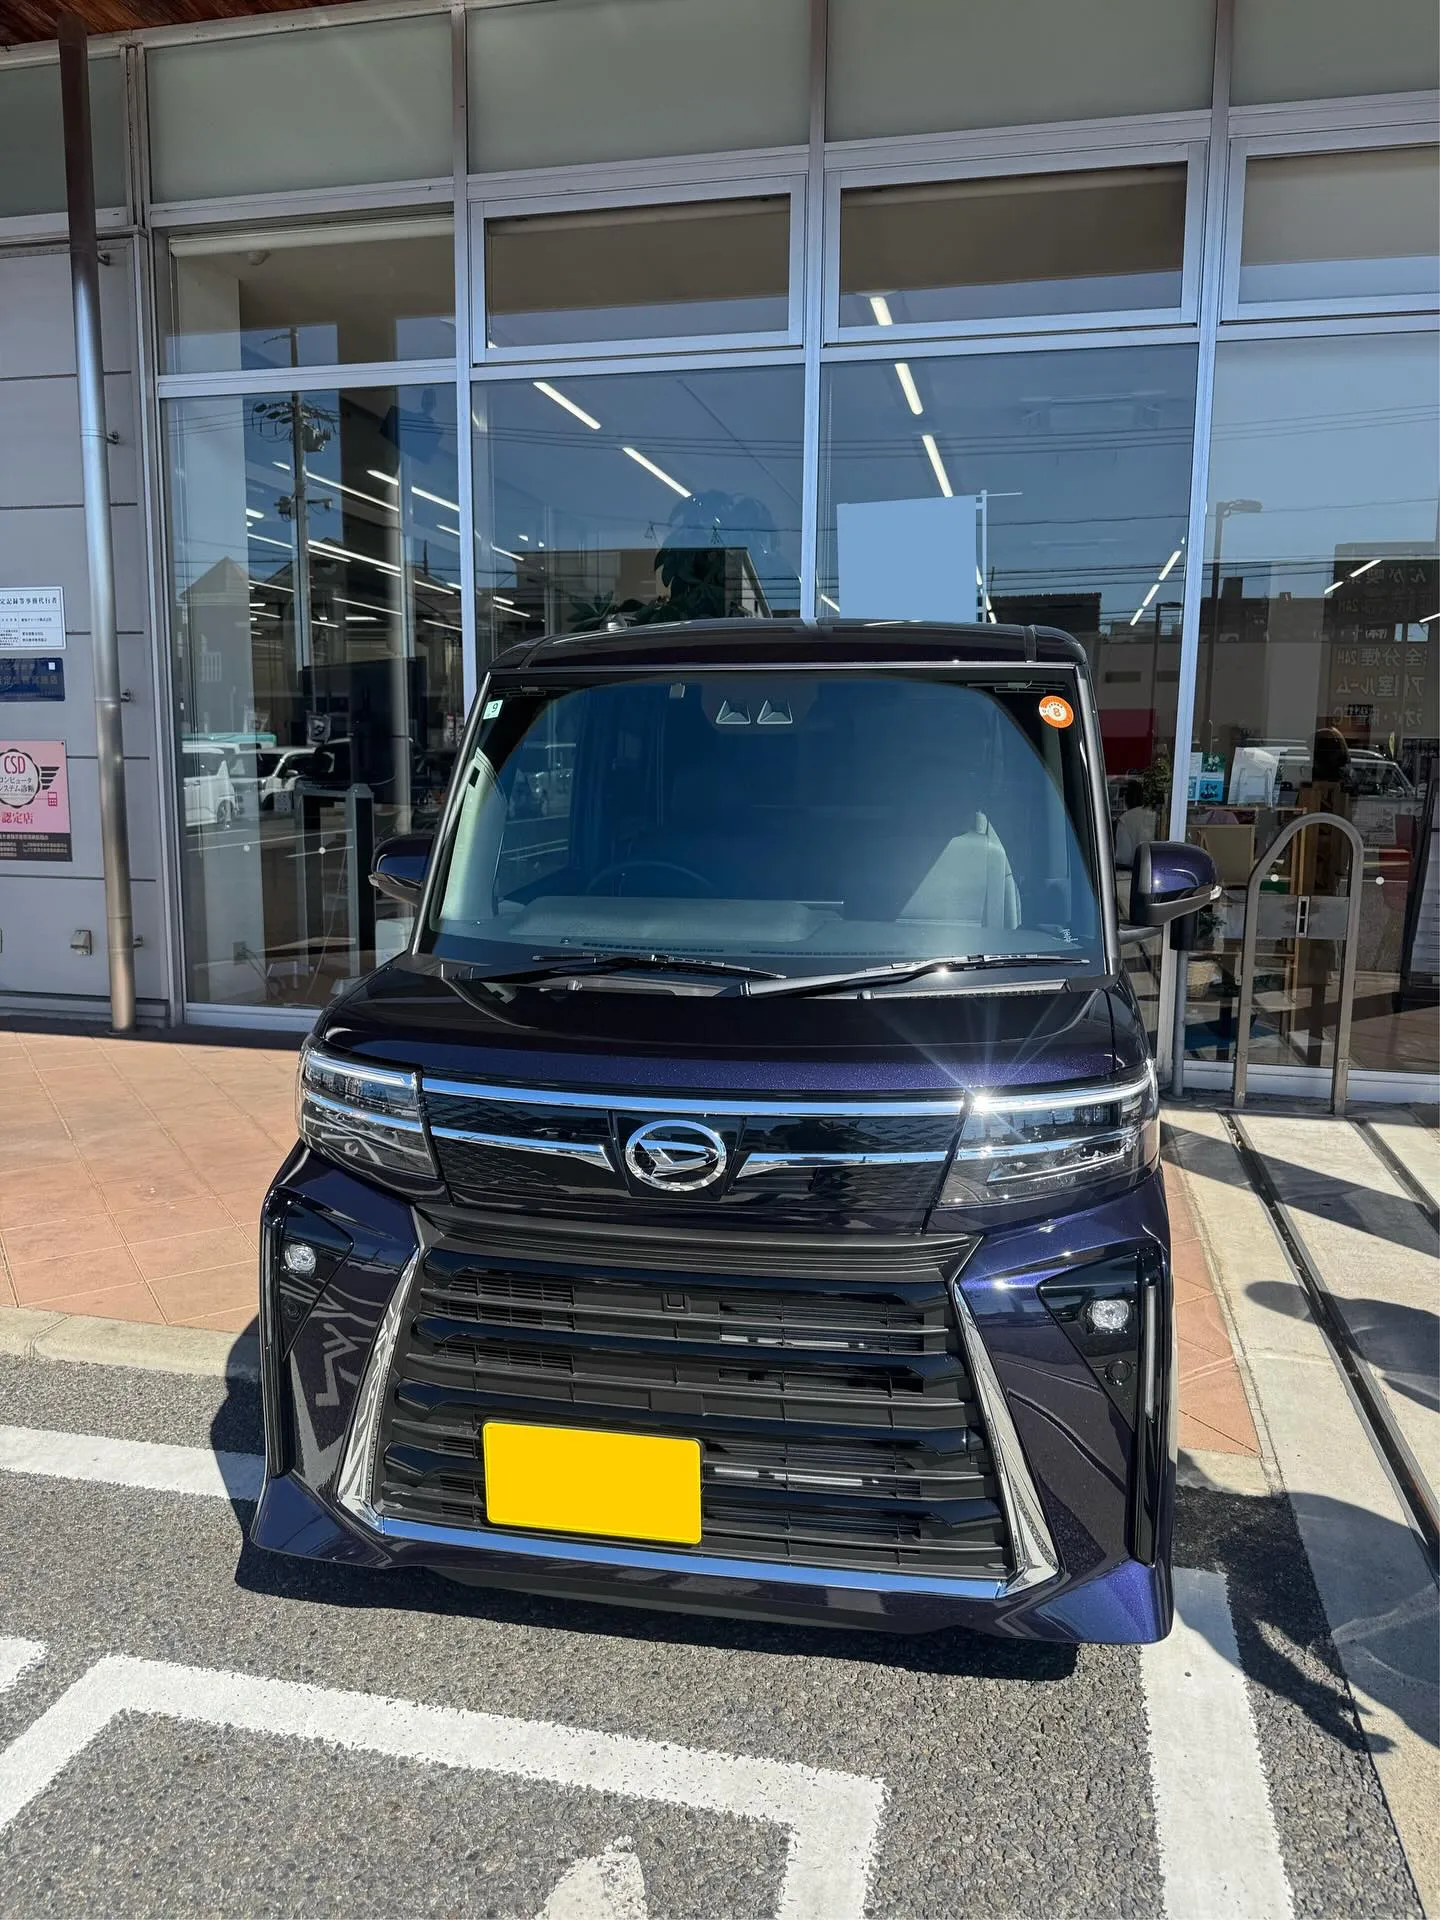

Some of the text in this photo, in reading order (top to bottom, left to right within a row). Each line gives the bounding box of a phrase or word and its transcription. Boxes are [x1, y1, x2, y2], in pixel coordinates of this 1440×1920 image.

[4, 755, 26, 775] CSD
[2, 812, 33, 824] 認定店
